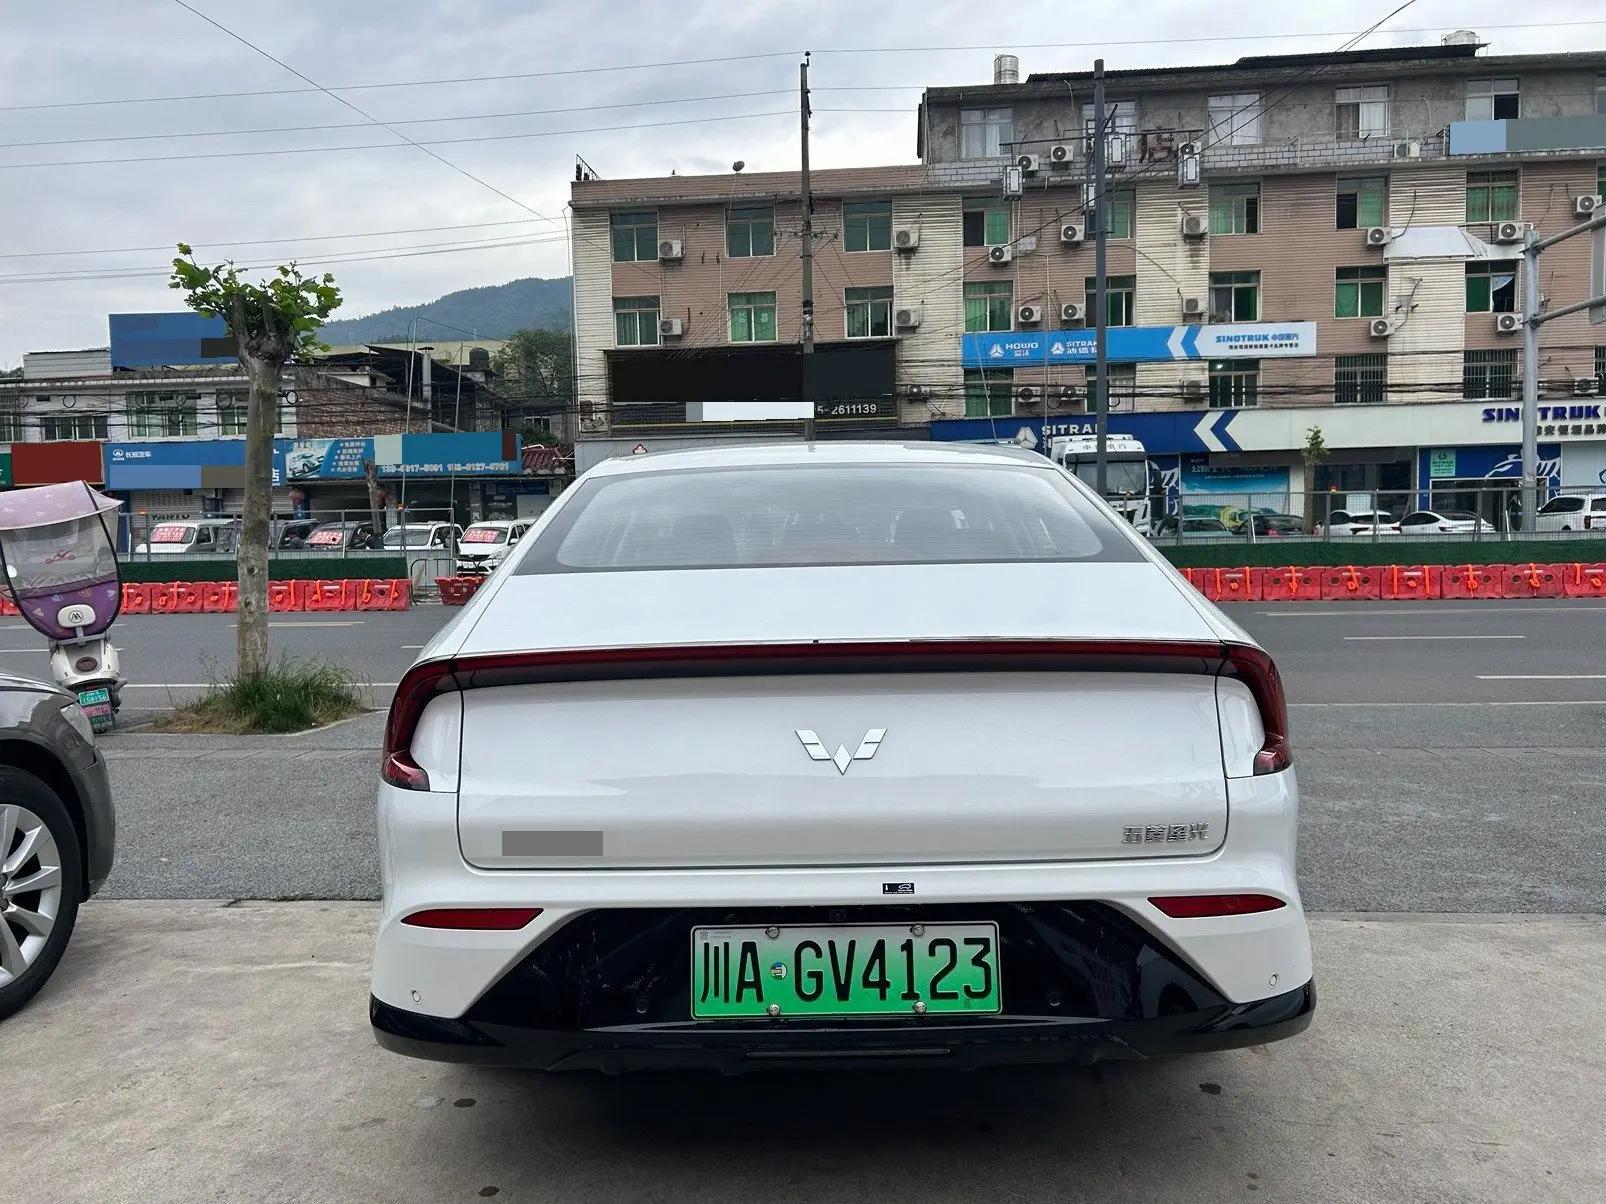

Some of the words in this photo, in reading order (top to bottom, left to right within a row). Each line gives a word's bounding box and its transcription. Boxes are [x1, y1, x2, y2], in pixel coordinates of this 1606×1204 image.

[1215, 334, 1270, 343] SINOTRUK
[1005, 342, 1039, 350] HOWO
[1482, 406, 1601, 422] SINTRUK
[1041, 423, 1098, 436] SITRA
[700, 941, 764, 1003] 川A
[794, 937, 993, 1002] GV4123
